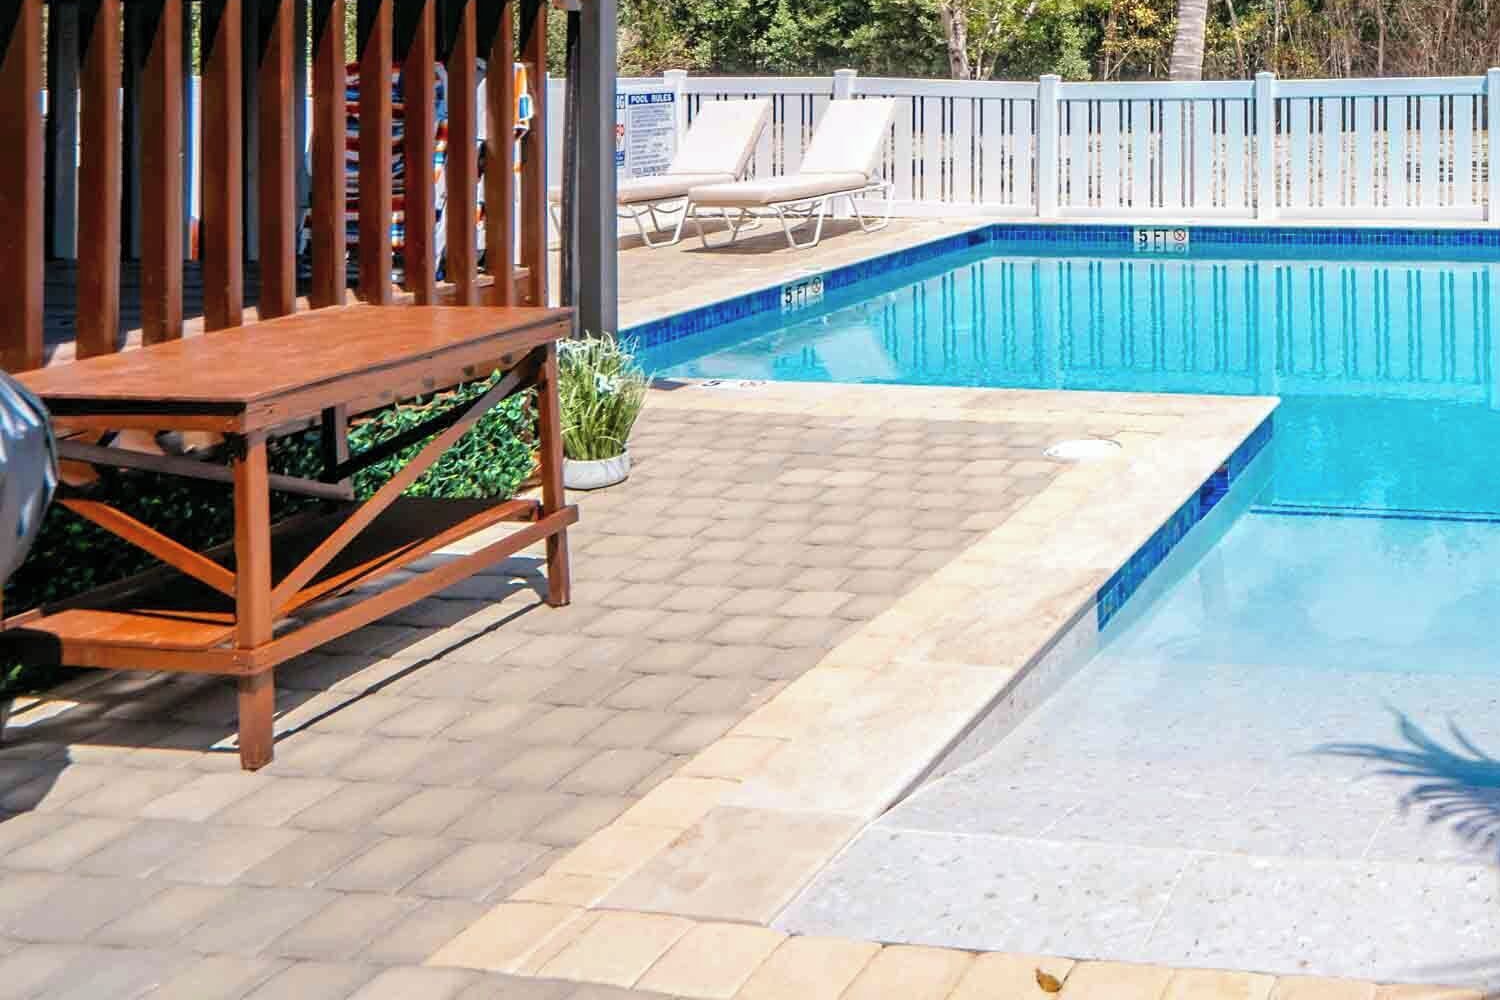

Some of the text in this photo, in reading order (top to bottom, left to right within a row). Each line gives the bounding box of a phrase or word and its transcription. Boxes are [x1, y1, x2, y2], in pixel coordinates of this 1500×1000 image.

[631, 95, 648, 104] POOL
[651, 93, 673, 102] RULES
[1138, 229, 1168, 243] 5 FT
[785, 281, 809, 304] 5 FT
